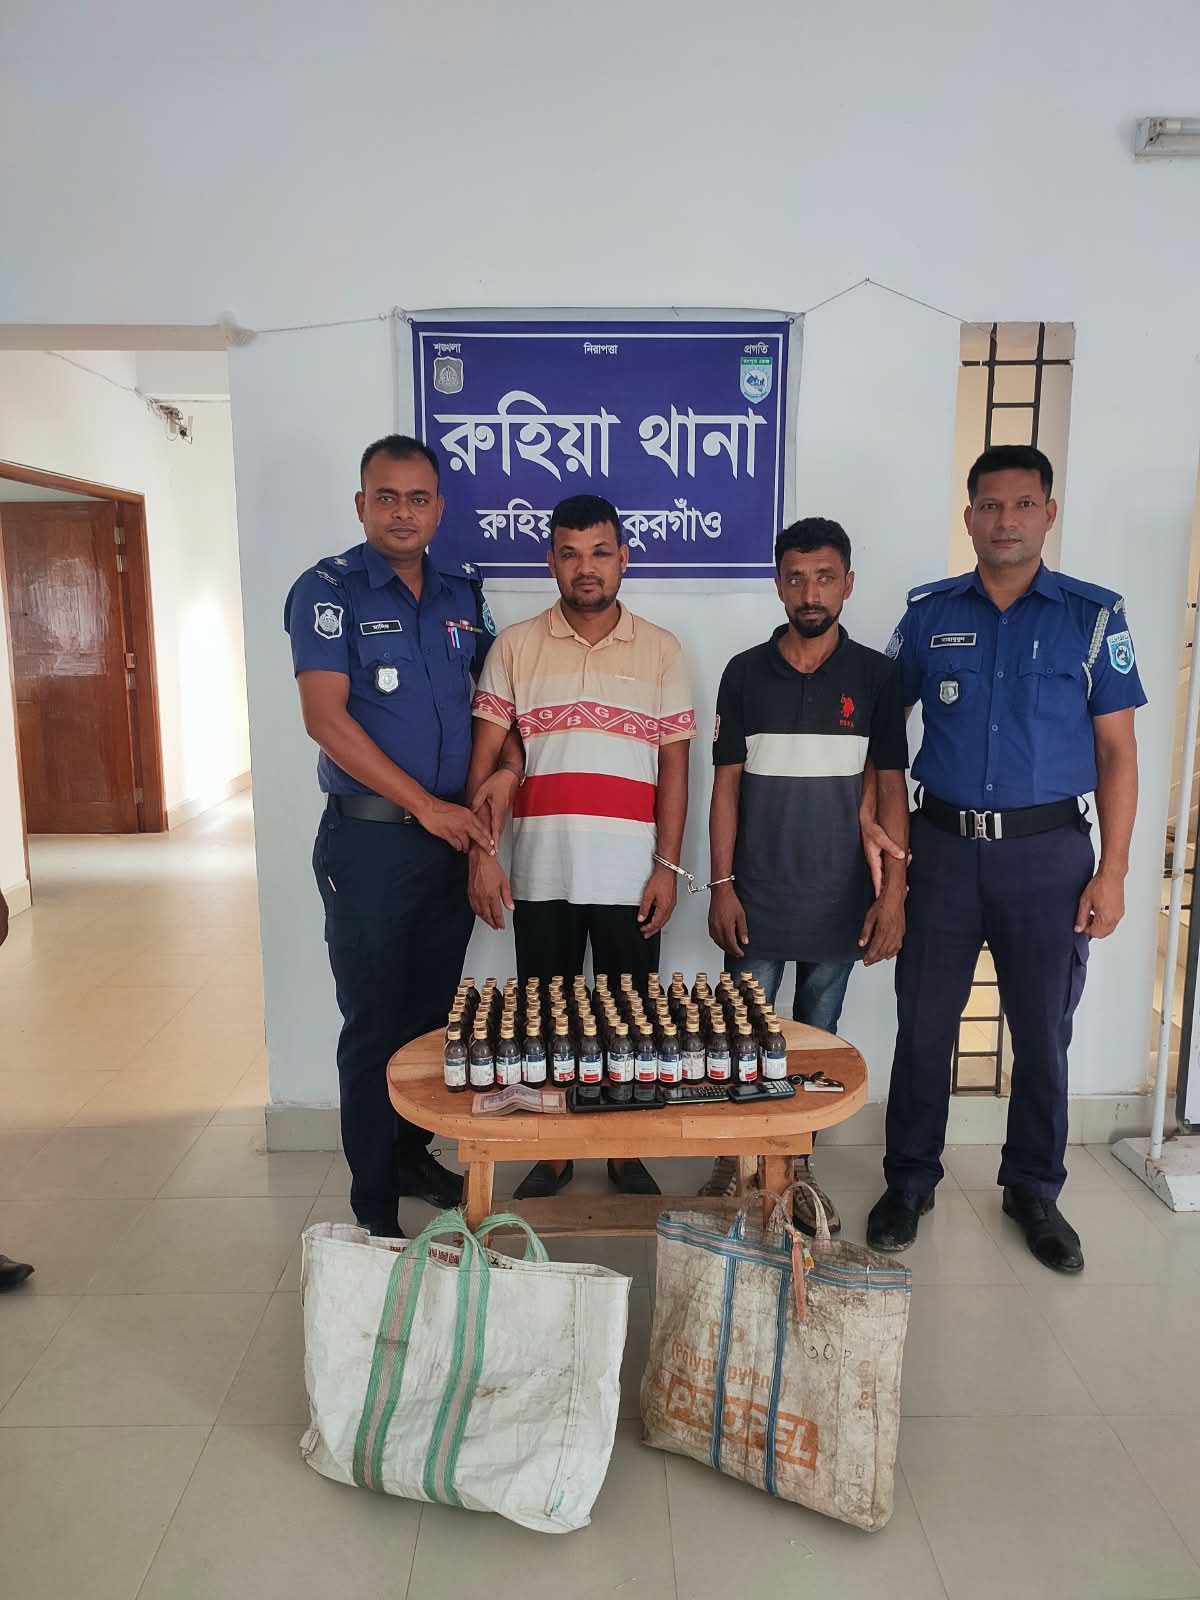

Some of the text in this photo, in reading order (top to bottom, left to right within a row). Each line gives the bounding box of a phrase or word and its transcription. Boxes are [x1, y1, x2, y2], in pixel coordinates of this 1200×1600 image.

[584, 341, 618, 355] নিরাপত্তা
[744, 342, 769, 354] প্রগতি
[433, 390, 768, 482] রুহিয়া থানা
[476, 497, 553, 543] রুহিয়
